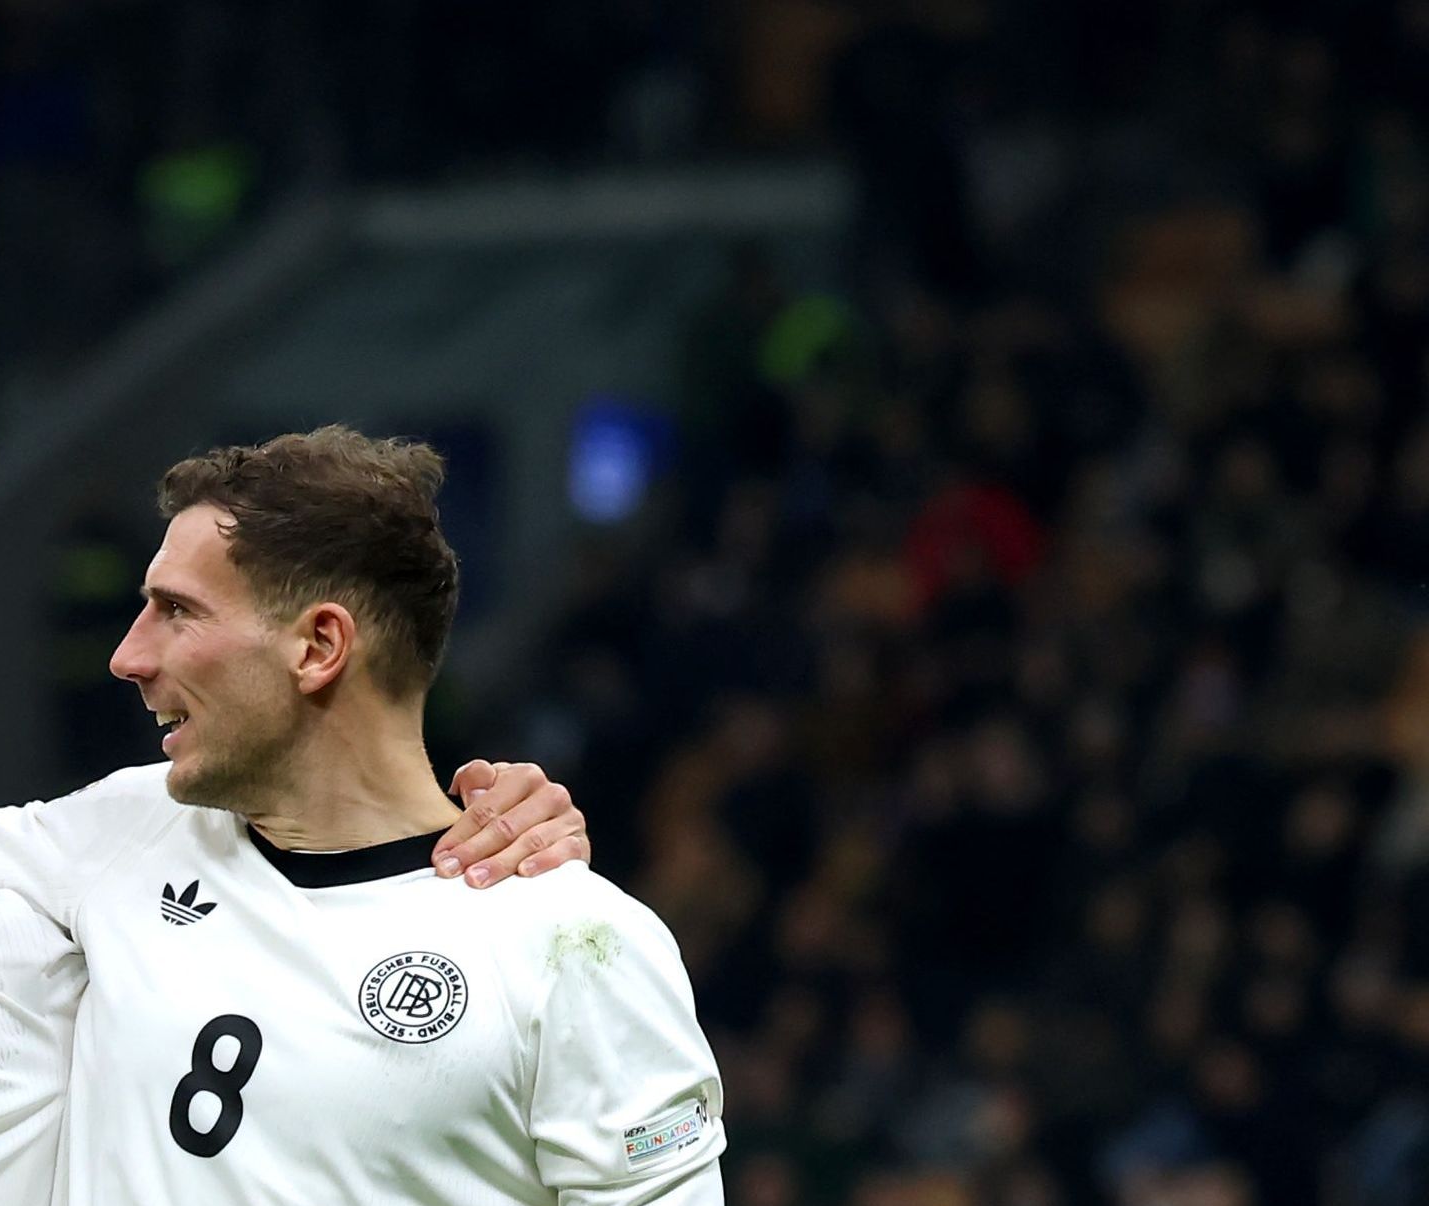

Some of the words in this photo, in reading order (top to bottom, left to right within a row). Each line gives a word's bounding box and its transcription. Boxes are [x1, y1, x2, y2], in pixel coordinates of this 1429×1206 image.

[366, 956, 413, 1018] DEUTSCHER
[417, 955, 462, 1038] FUSSBALL-BUND
[169, 1013, 263, 1158] 8
[626, 1119, 697, 1155] FOUNDATION
